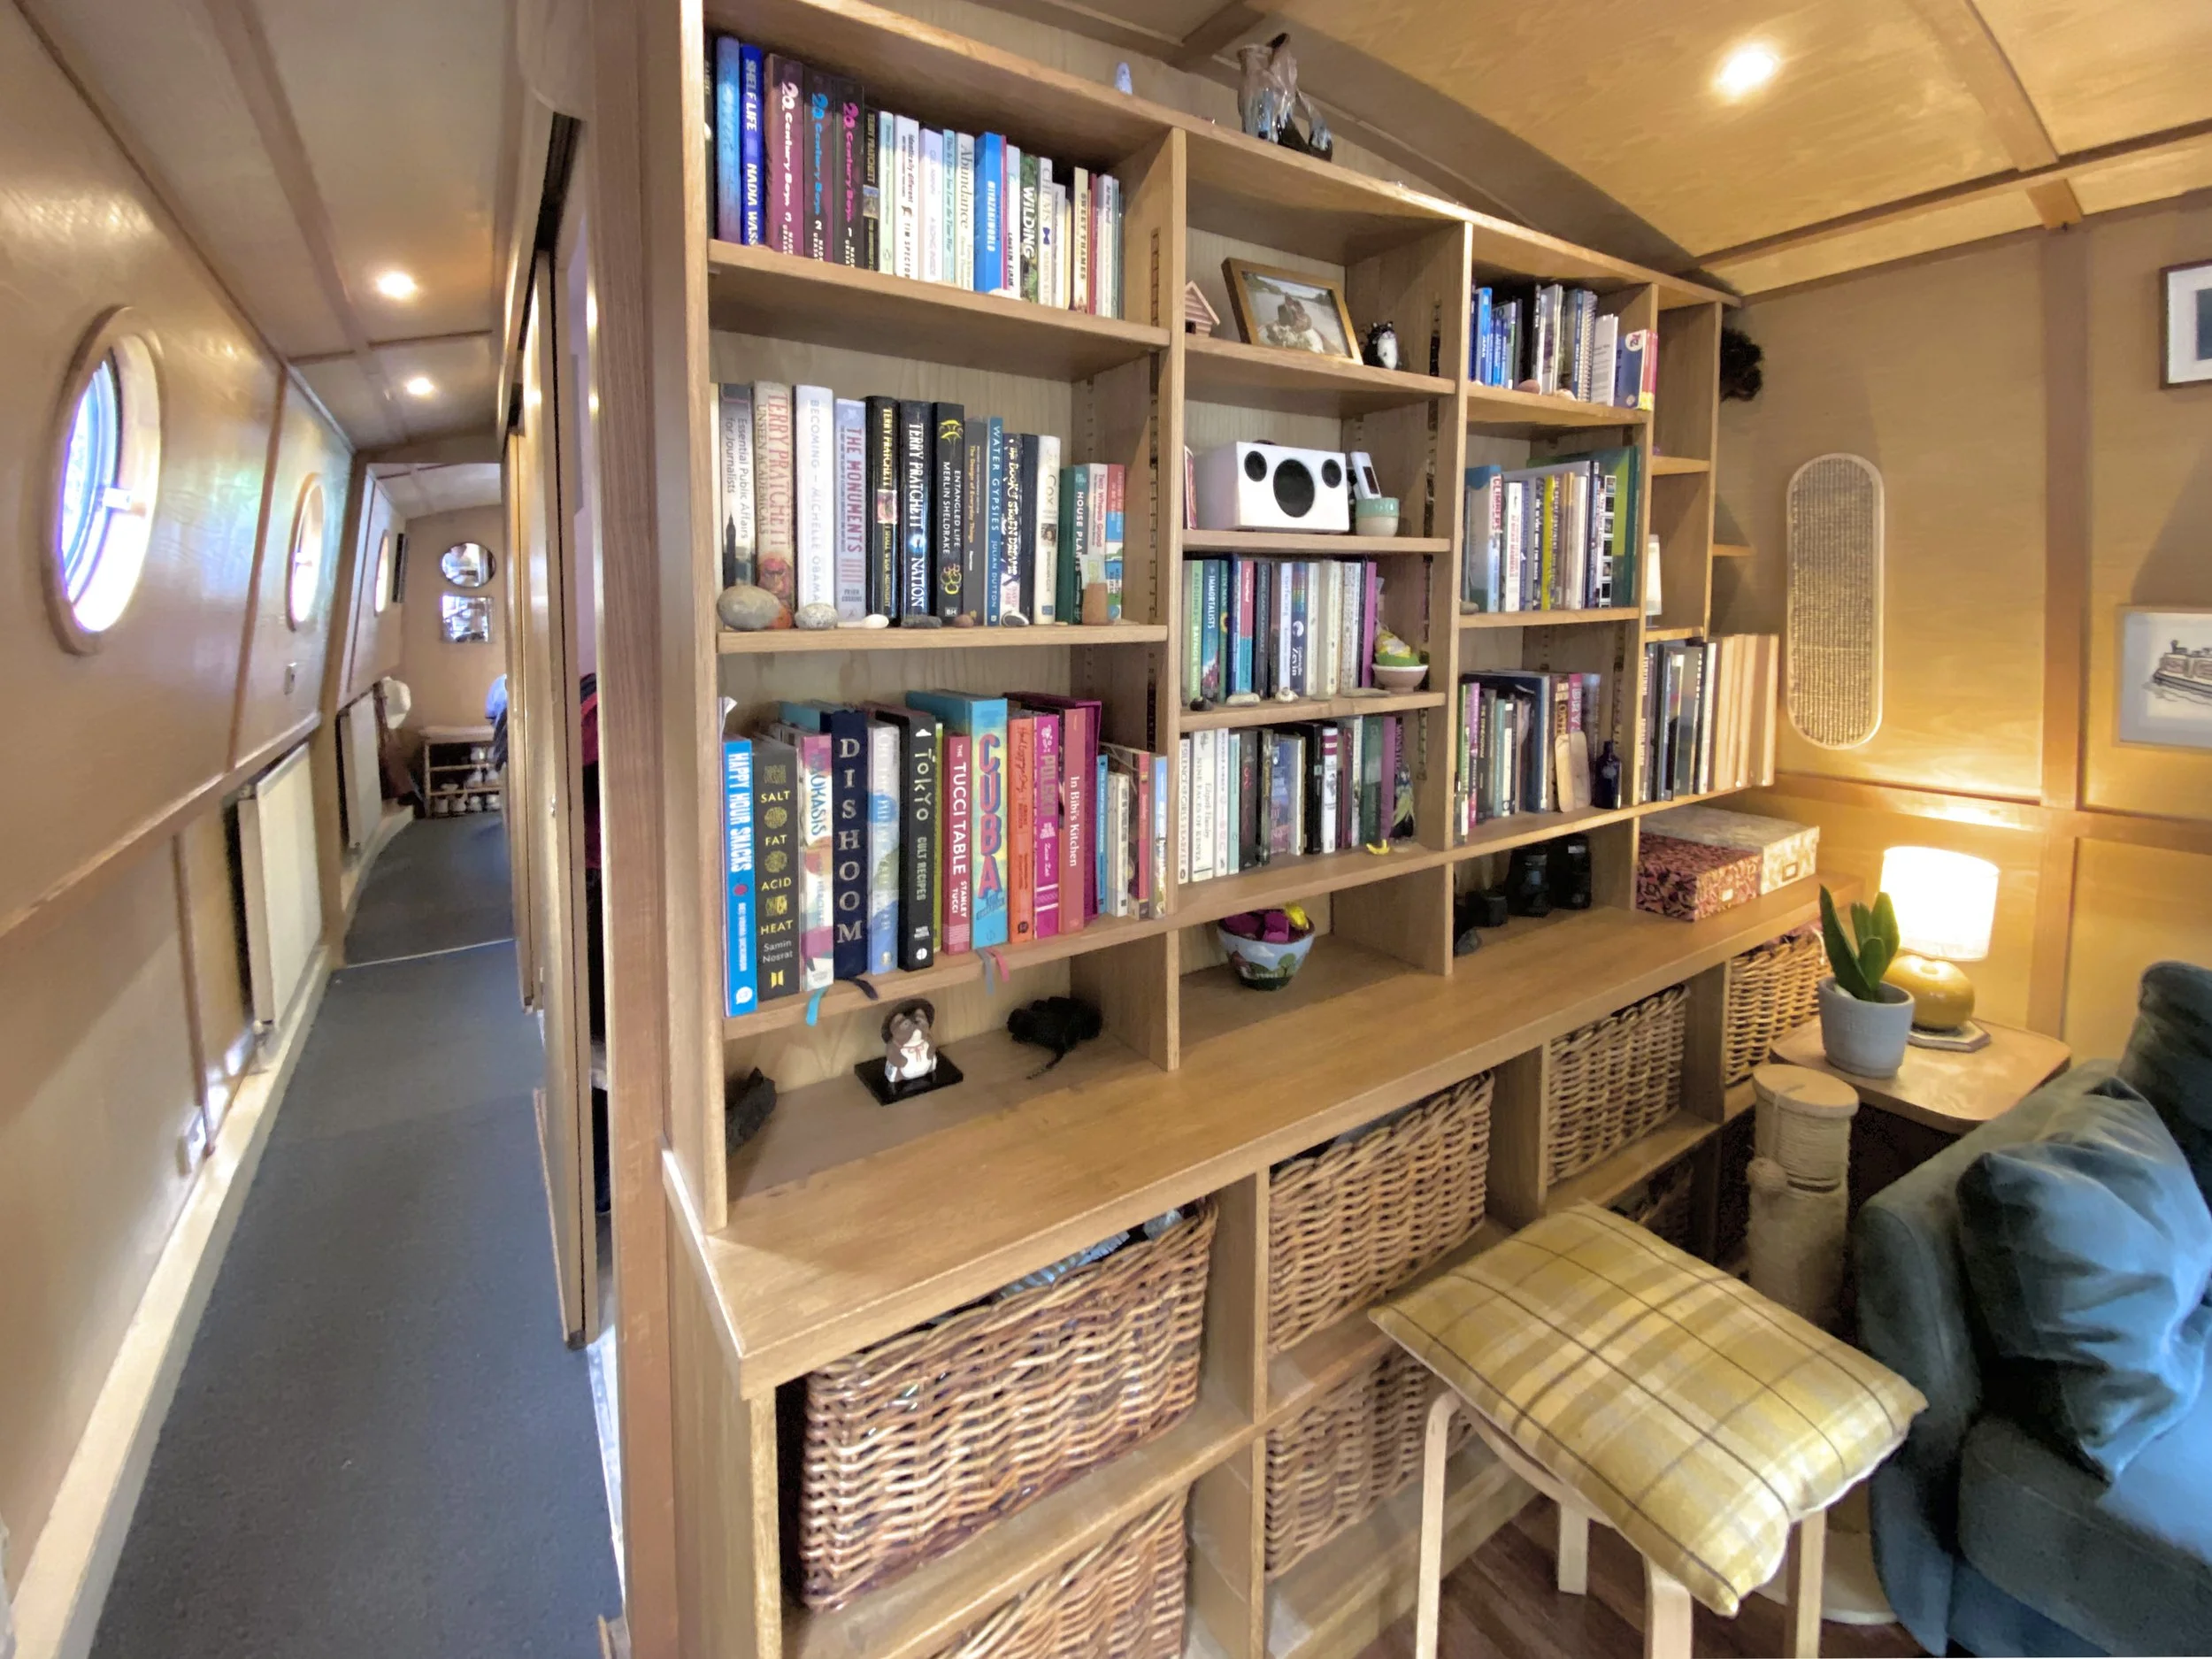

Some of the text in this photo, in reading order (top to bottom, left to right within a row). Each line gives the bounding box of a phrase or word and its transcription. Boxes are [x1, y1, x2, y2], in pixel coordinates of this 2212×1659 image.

[746, 58, 758, 132] SHELF LIFE
[783, 112, 793, 171] Century
[814, 123, 823, 179] Century
[845, 131, 854, 187] Century
[867, 138, 876, 184] PRATCHETT
[747, 163, 758, 245] NADIA WASS
[784, 173, 793, 206] Boys
[814, 181, 823, 215] Boys
[960, 144, 973, 229] Abundance
[987, 180, 996, 252] MIYAZAKIWORLD
[1023, 186, 1035, 257] WILDING
[726, 417, 737, 494] for Journalists
[757, 403, 769, 535] UNSEEN ACADEMICALS
[767, 394, 790, 548] TERRY PRATCHETT
[883, 408, 893, 487] TERRY PRATCHETT
[736, 418, 751, 539] Essential Public Affairs
[810, 399, 822, 603] BECOMING MICHELLE OBAMA
[846, 428, 863, 553] THE MONUMENTS
[909, 423, 924, 530] TERRY PRATCHETT
[992, 426, 1002, 532] WATER GYPSIES
[942, 500, 951, 555] SHELDRAKE
[1008, 501, 1019, 534] STOLEN
[911, 557, 925, 609] NATION
[1207, 575, 1216, 629] IMMORTALISTS
[728, 752, 752, 873] HAPPY HOUR SNACKS
[760, 790, 790, 803] SALT
[952, 762, 967, 817] TUCCI
[1040, 755, 1056, 817] POLSKA
[764, 834, 788, 846] FAT
[836, 738, 863, 944] DISHOOM
[978, 733, 1003, 899] CUBA
[1070, 776, 1080, 866] In Bibi's Kitchen
[1195, 813, 1202, 827] OF
[917, 837, 927, 859] CULT
[952, 820, 967, 875] TABLE
[761, 878, 792, 891] ACID
[917, 862, 926, 901] RECIPES
[760, 920, 794, 935] HEAT
[763, 940, 792, 953] Samin
[763, 950, 794, 964] Nosrat
